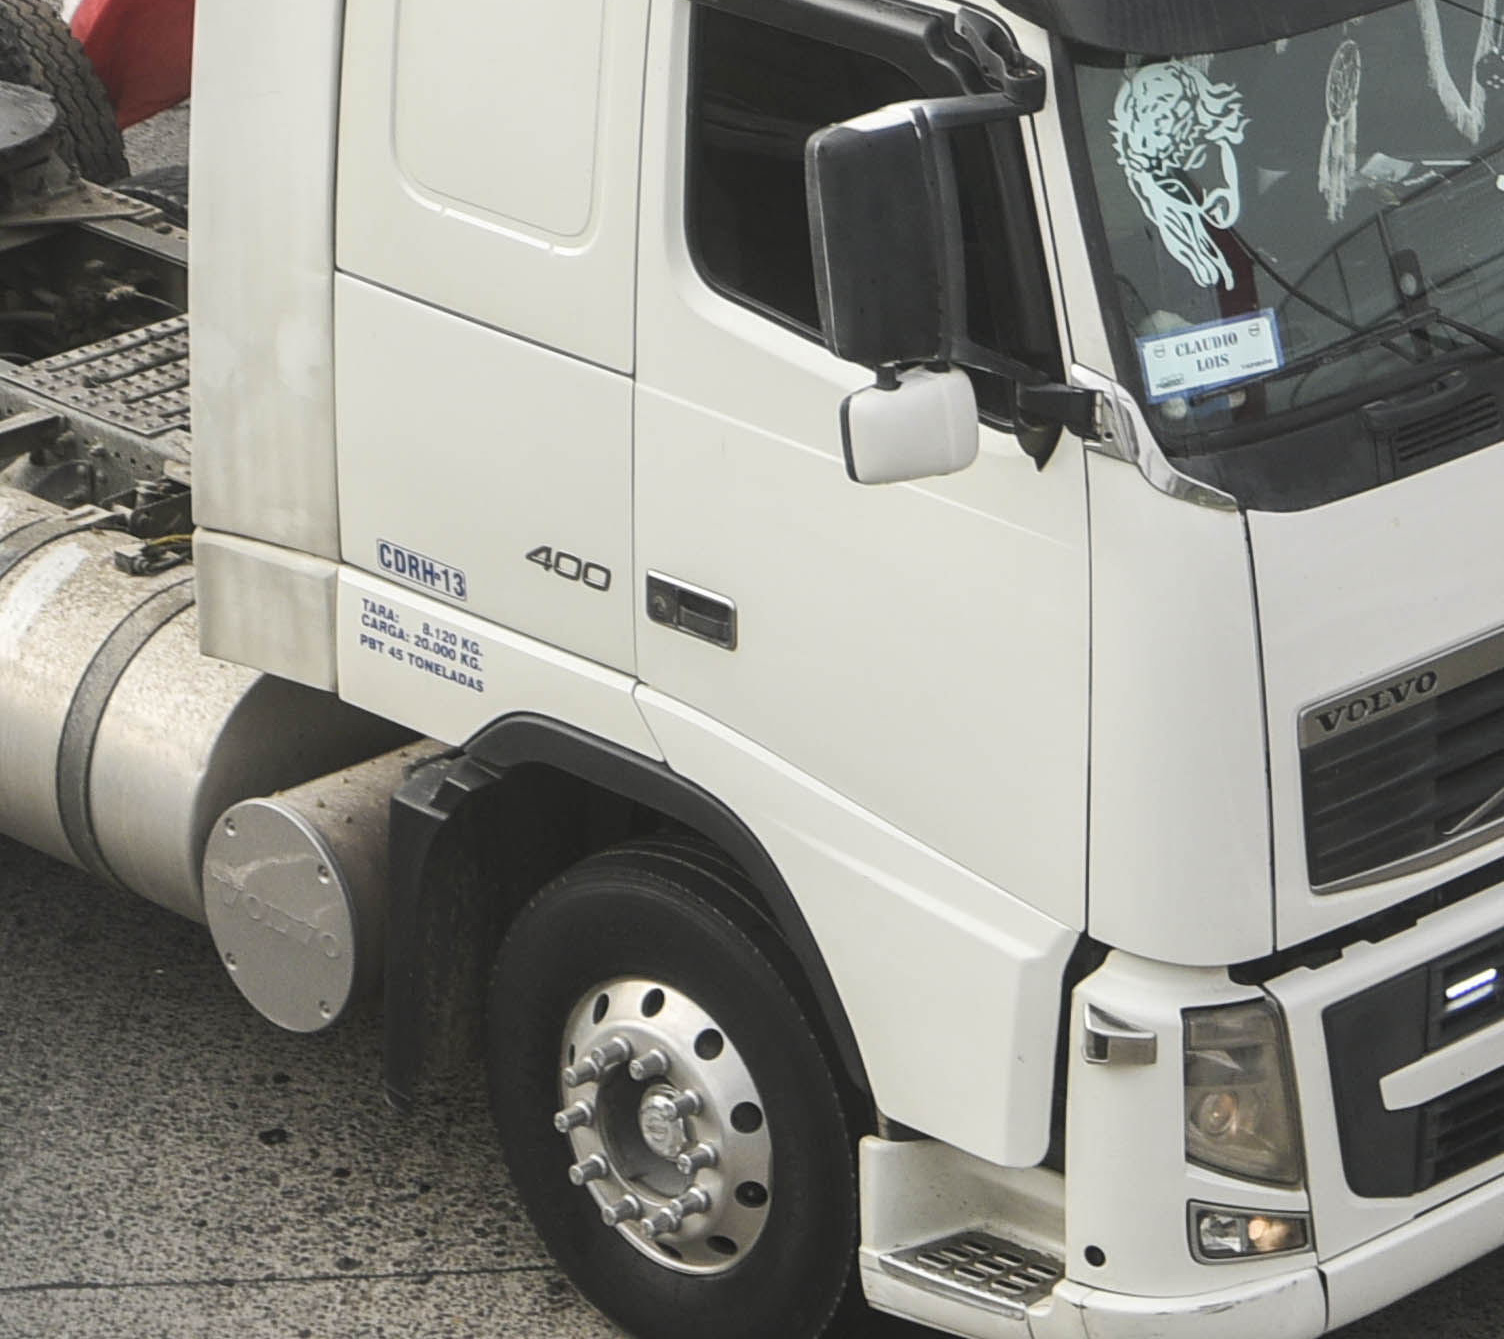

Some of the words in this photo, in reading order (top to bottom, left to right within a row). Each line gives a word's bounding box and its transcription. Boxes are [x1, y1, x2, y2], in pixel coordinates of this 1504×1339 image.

[1175, 332, 1238, 357] CLAUDIO
[1196, 353, 1230, 372] LOIS
[525, 545, 612, 592] 400
[361, 614, 410, 643] CARGA:
[414, 634, 456, 661] 20.000
[460, 650, 484, 672] KG.
[362, 598, 400, 623] TARA:
[422, 622, 456, 646] 8.120
[461, 634, 484, 657] KG.
[360, 633, 385, 654] PBT
[388, 646, 404, 661] 45
[407, 651, 485, 693] TONELADAS
[1315, 670, 1438, 732] VOLVO
